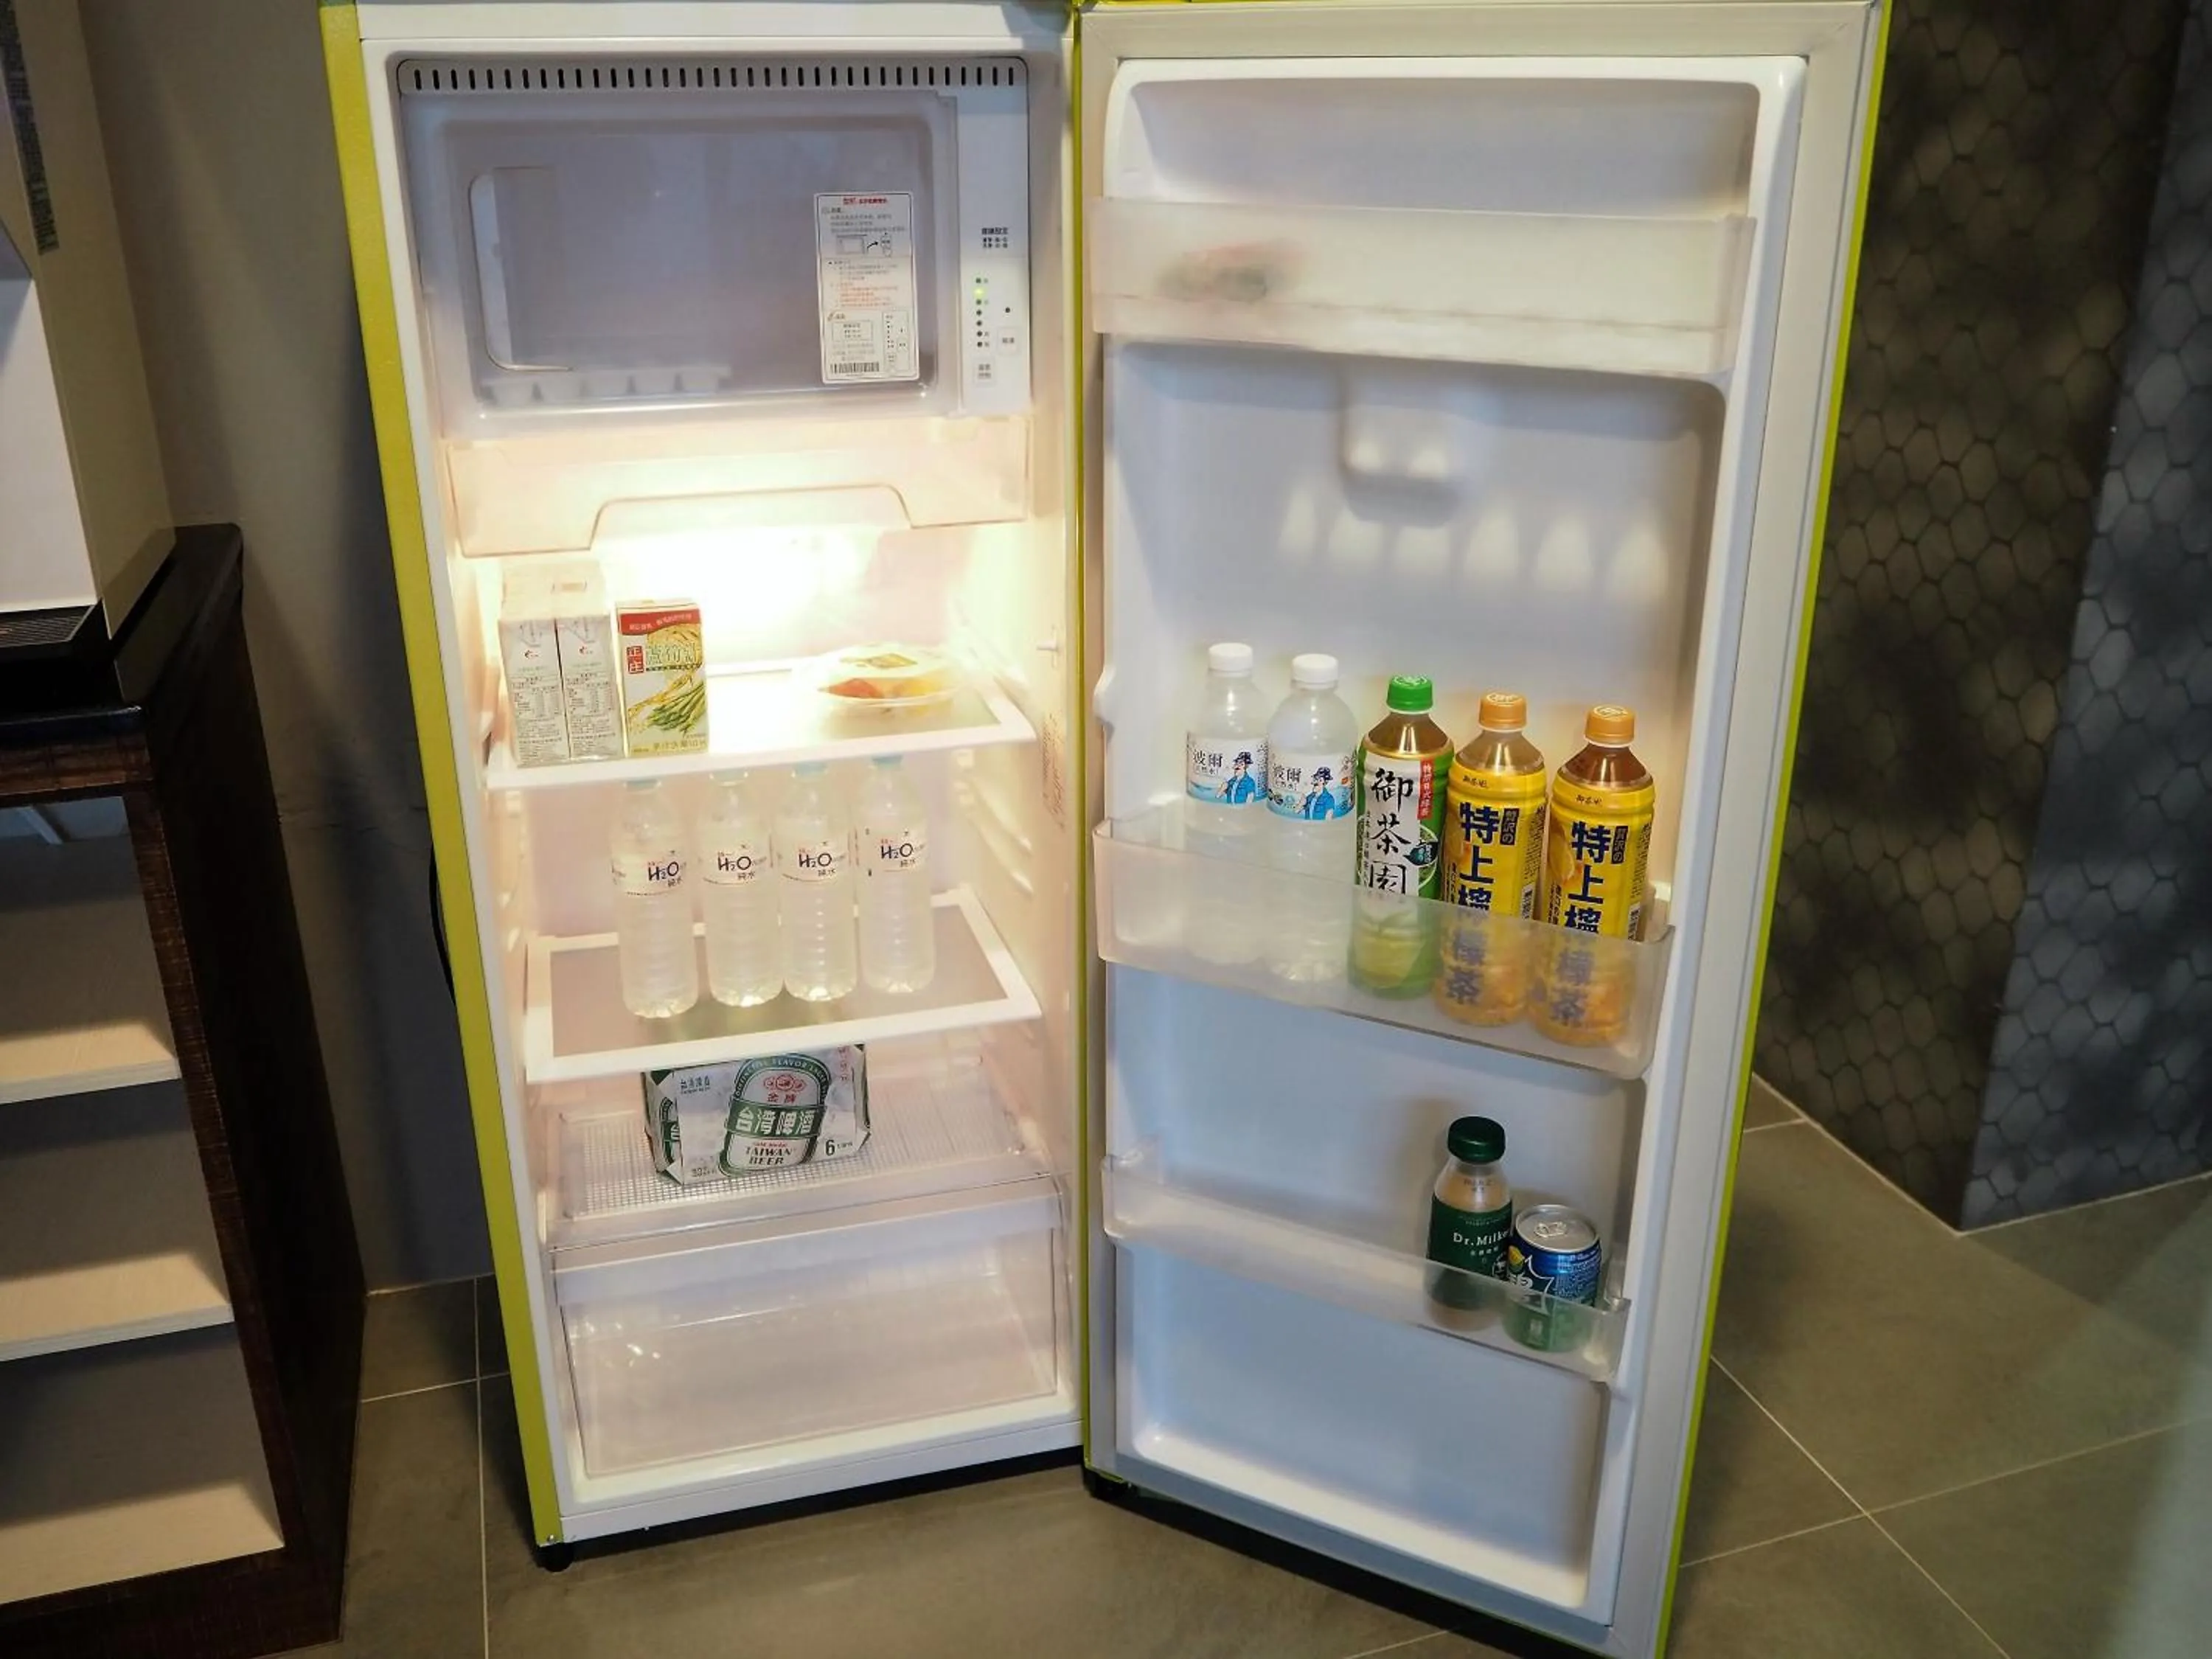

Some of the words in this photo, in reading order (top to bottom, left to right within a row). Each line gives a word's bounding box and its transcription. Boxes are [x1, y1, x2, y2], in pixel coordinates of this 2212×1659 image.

[1193, 749, 1223, 767] 波爾
[1368, 768, 1413, 894] 御茶園
[735, 1107, 815, 1135] 台灣啤酒
[746, 1147, 792, 1156] TAIWAN
[826, 1139, 835, 1157] 6
[749, 1157, 784, 1165] BEER
